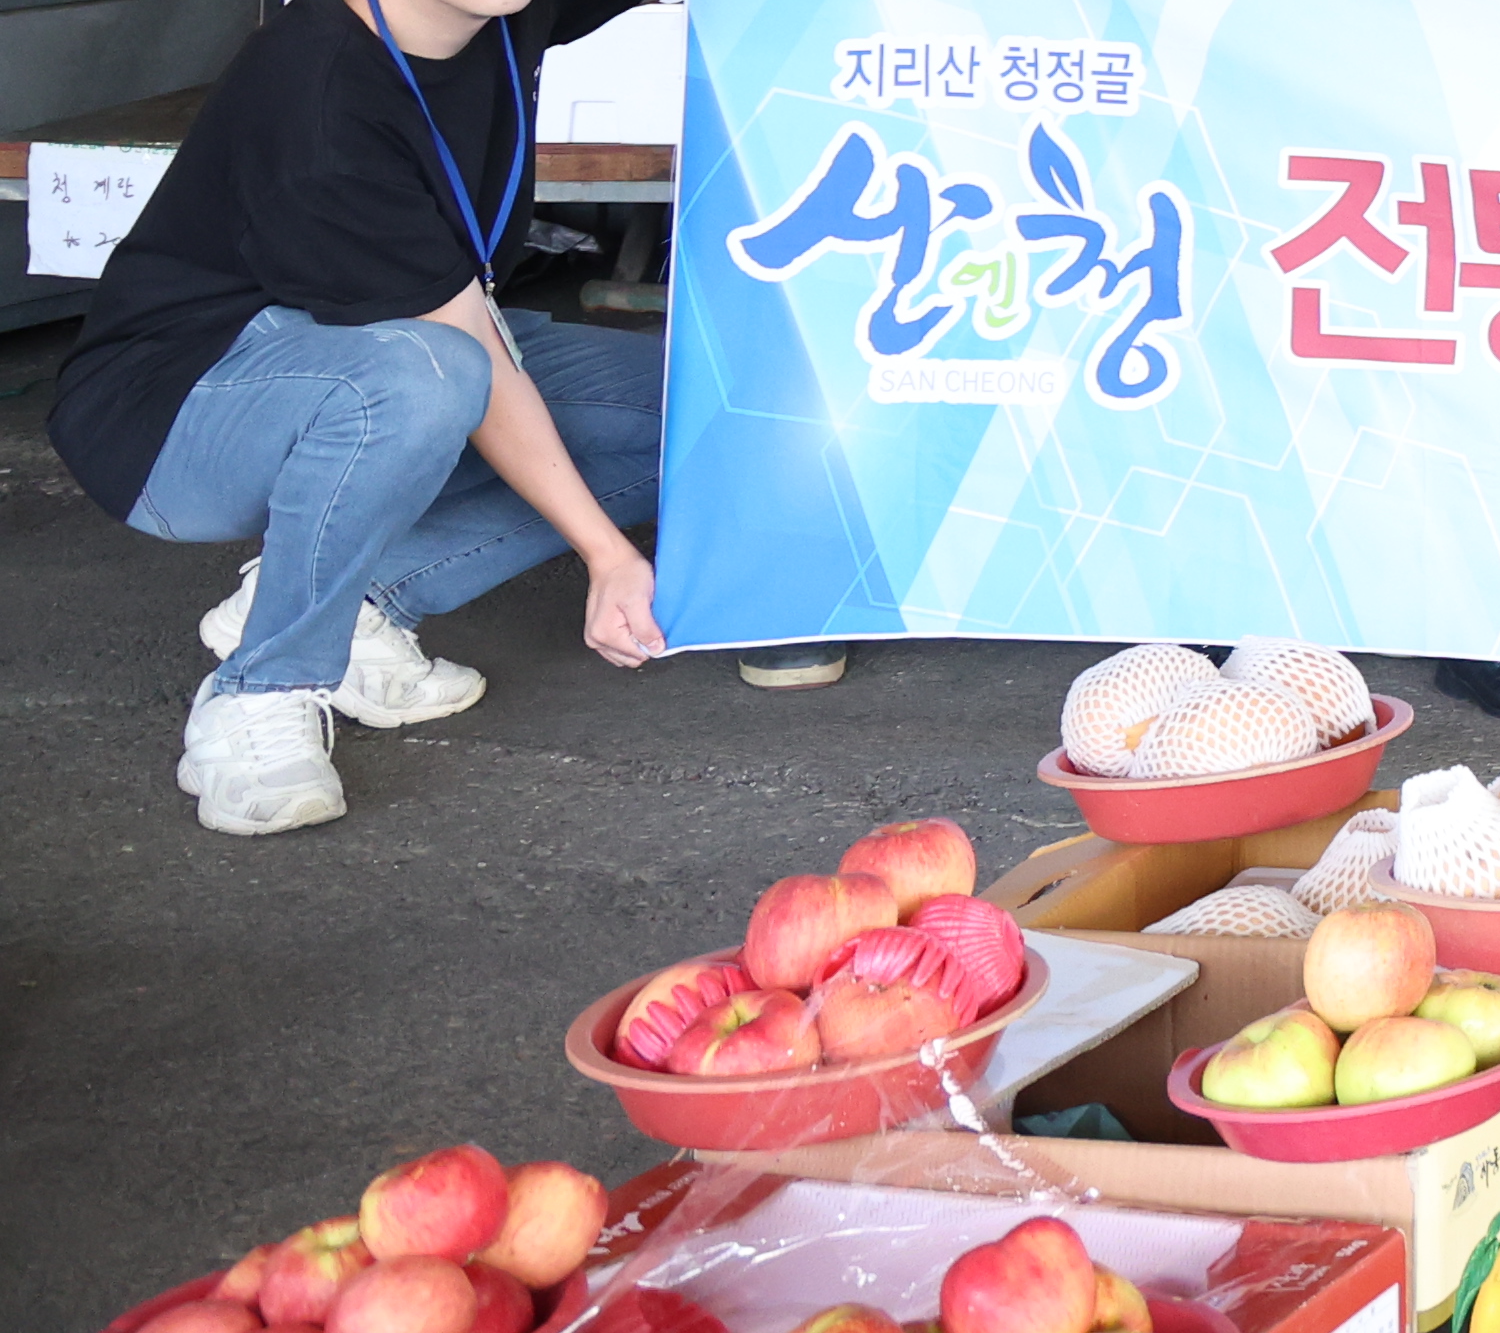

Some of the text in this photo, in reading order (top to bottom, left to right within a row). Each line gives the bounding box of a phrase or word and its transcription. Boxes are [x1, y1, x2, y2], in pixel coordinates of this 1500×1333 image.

[842, 43, 1136, 106] 지리산 청정골
[879, 368, 1056, 395] SAN CHEONG
